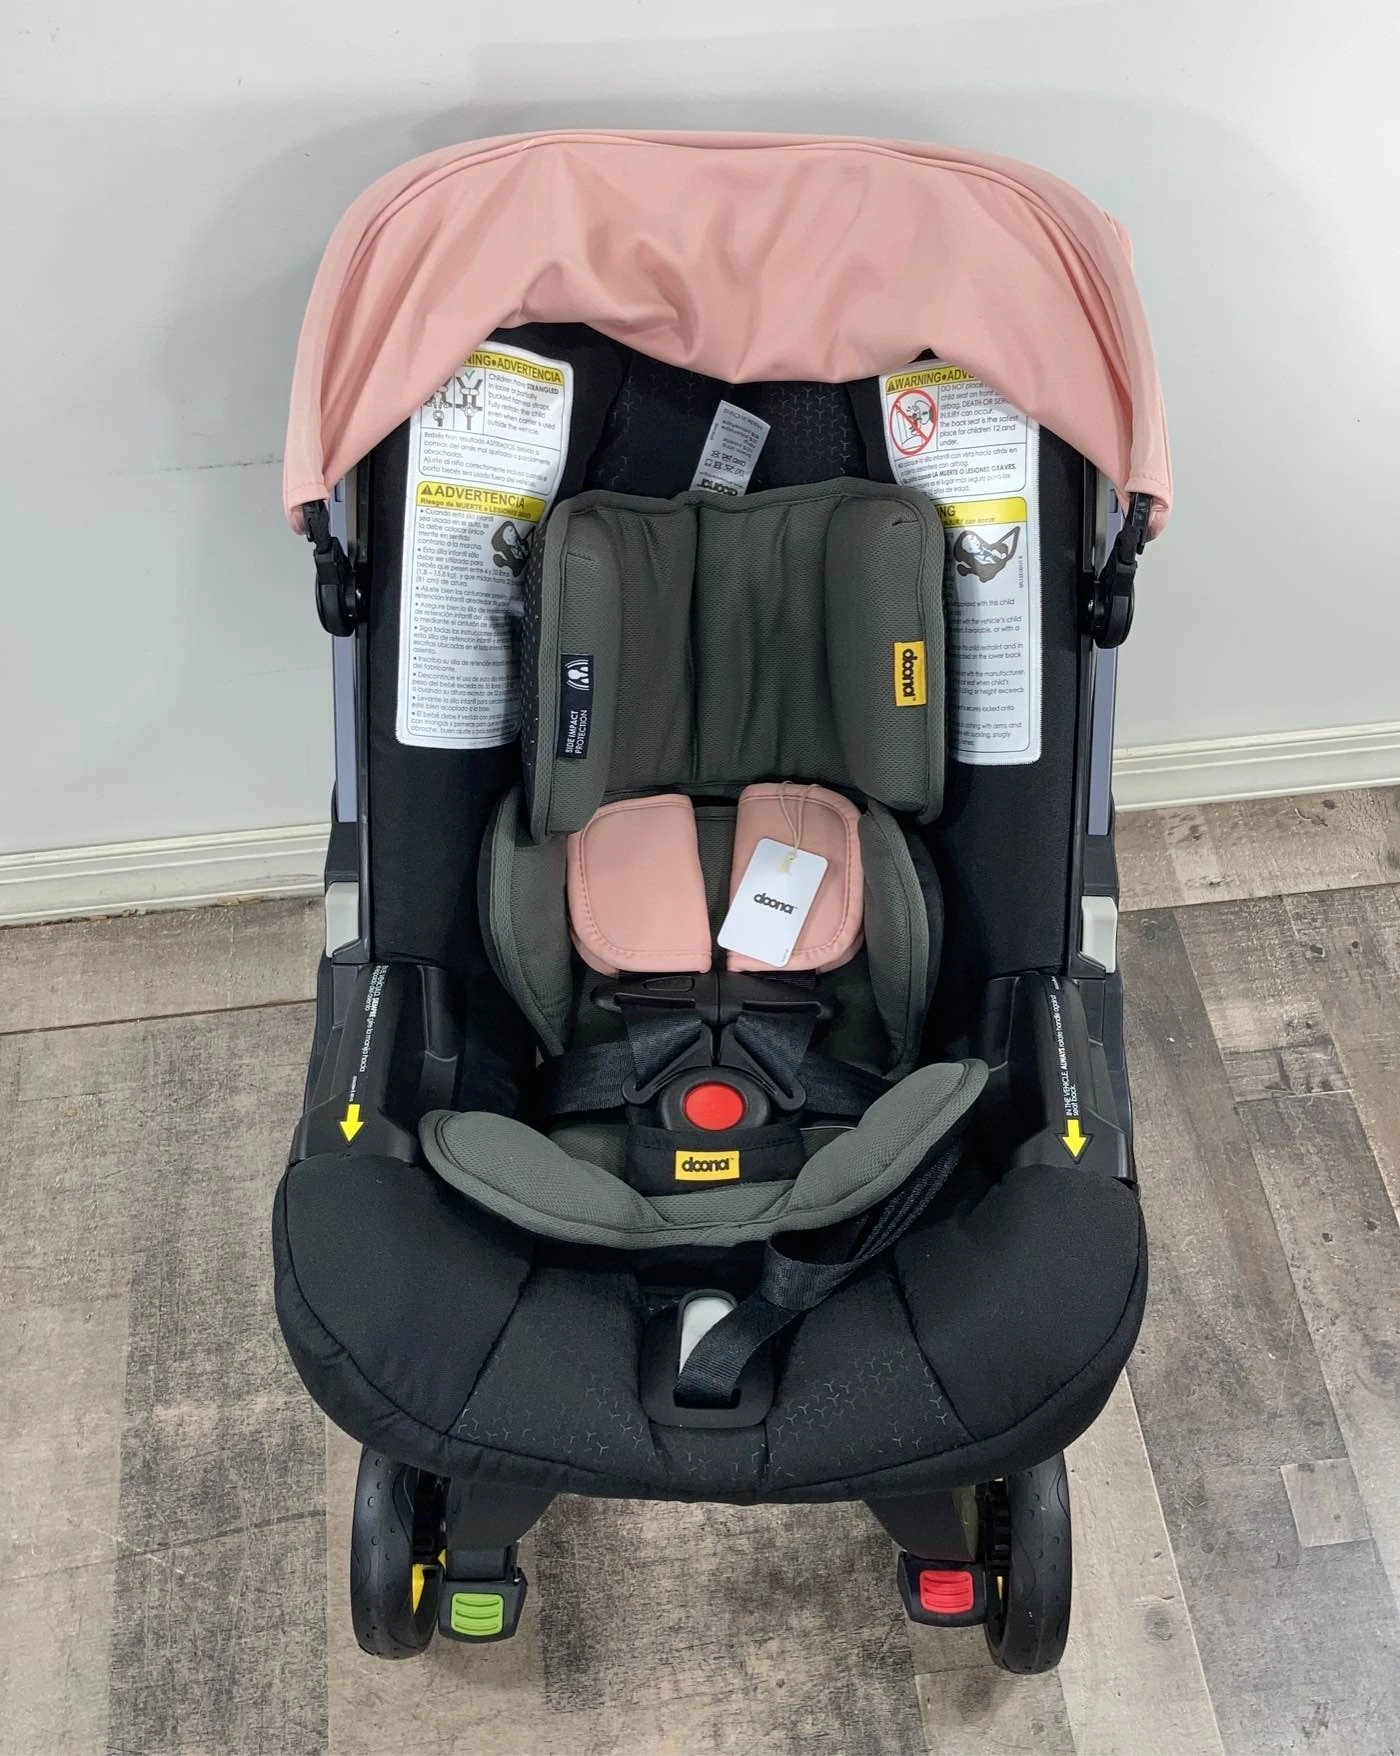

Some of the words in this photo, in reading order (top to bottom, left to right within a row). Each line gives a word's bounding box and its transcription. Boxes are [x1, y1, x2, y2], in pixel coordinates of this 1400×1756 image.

[464, 353, 492, 367] NING
[497, 358, 561, 383] ADVERTENCIA
[895, 371, 941, 389] WARNING
[962, 400, 982, 408] DEATH
[1001, 423, 1016, 431] and
[939, 468, 958, 477] MUERTE
[434, 485, 525, 509] ADVERTENCIA
[456, 501, 483, 512] MUERTE
[902, 648, 917, 697] doona
[569, 710, 579, 738] IMPACT
[574, 709, 588, 754] PROTECTION
[565, 738, 576, 753] SIDE
[753, 892, 794, 915] doona
[369, 997, 379, 1017] SIEMPRE
[1050, 994, 1060, 1012] against
[366, 1018, 374, 1029] gire
[1054, 1013, 1063, 1031] handle
[362, 1035, 371, 1055] manija
[1057, 1032, 1065, 1047] rotate
[360, 1055, 369, 1072] hacia
[1058, 1048, 1068, 1069] ALWAYS
[1069, 1084, 1077, 1101] back.
[1064, 1097, 1072, 1108] THE
[1071, 1102, 1079, 1116] seat
[682, 1156, 730, 1173] doona
